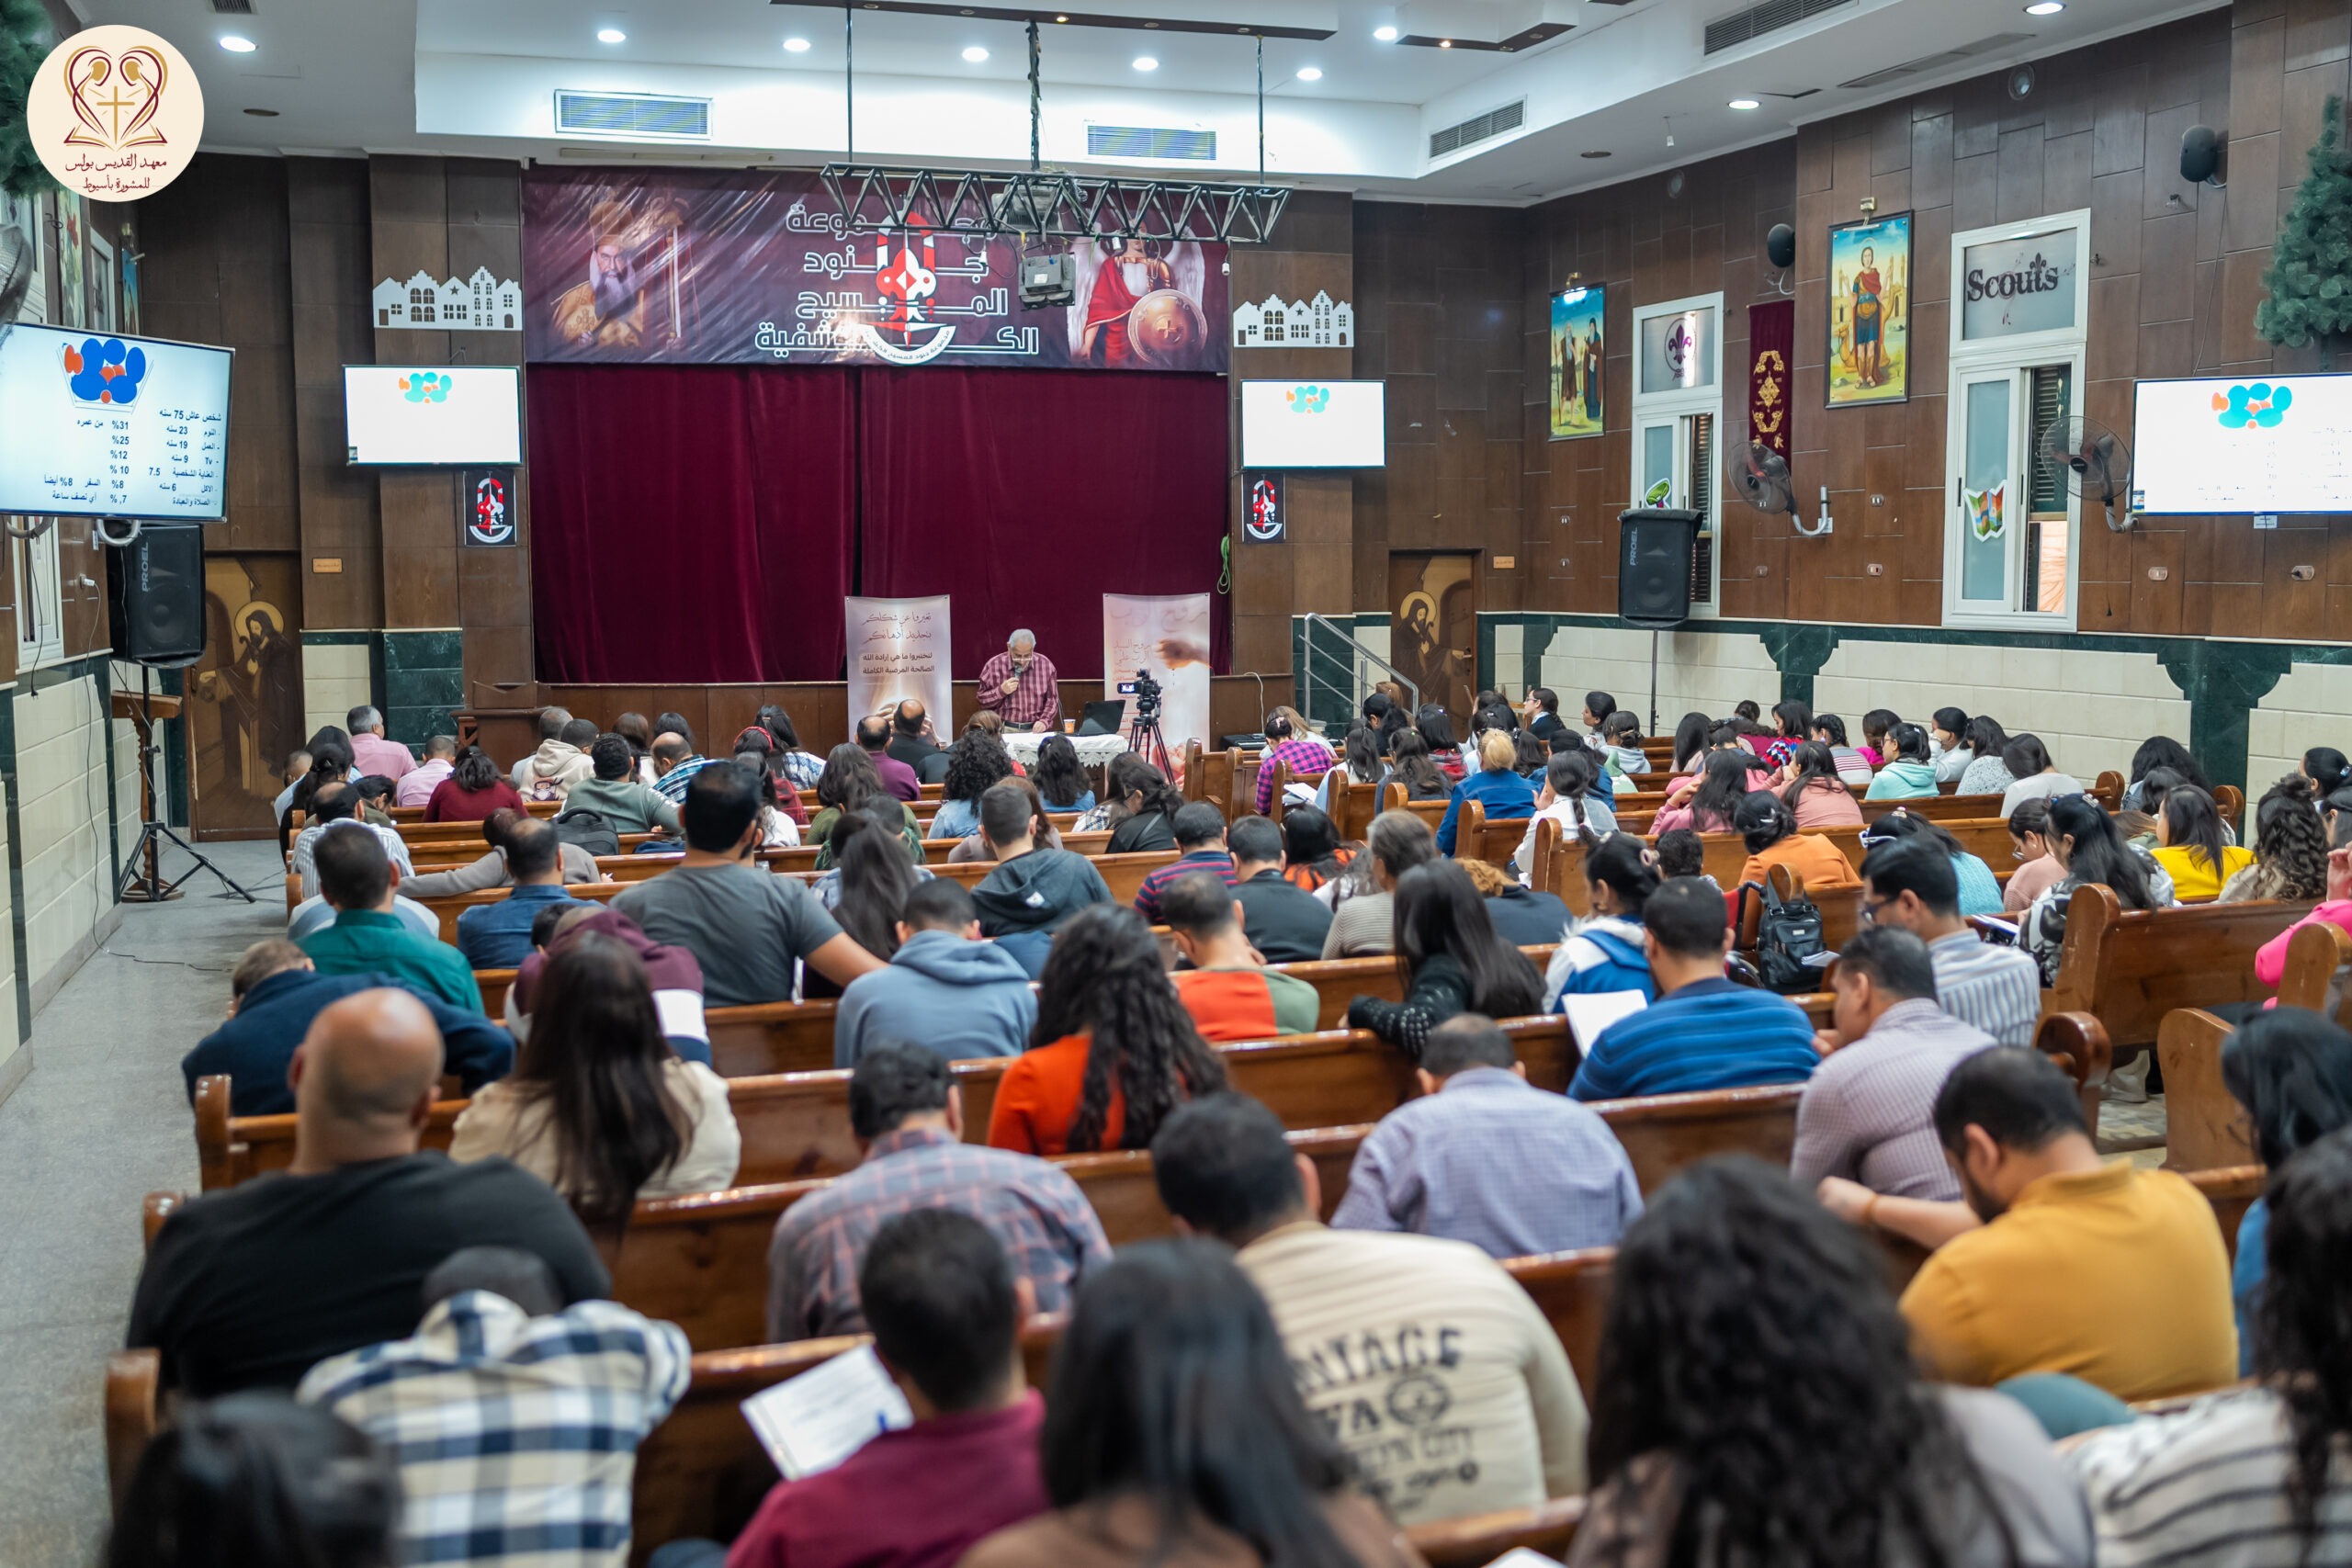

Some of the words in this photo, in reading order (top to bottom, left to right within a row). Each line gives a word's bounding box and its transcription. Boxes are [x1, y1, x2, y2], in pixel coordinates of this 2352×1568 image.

[804, 244, 989, 283] جنود
[1967, 255, 2059, 302] Scouts
[796, 288, 1008, 320] المسيح
[755, 321, 1039, 357] الكشفية
[174, 410, 184, 420] 75
[186, 411, 199, 421] عاش
[202, 412, 221, 423] شخص
[95, 421, 104, 429] من
[178, 426, 188, 435] 23
[179, 441, 188, 449] 19
[184, 455, 188, 463] 9
[149, 467, 161, 476] 7.5
[172, 483, 176, 491] 6
[1629, 526, 1637, 566] PROEL
[861, 611, 899, 626] شكلكم
[863, 653, 874, 661] الله
